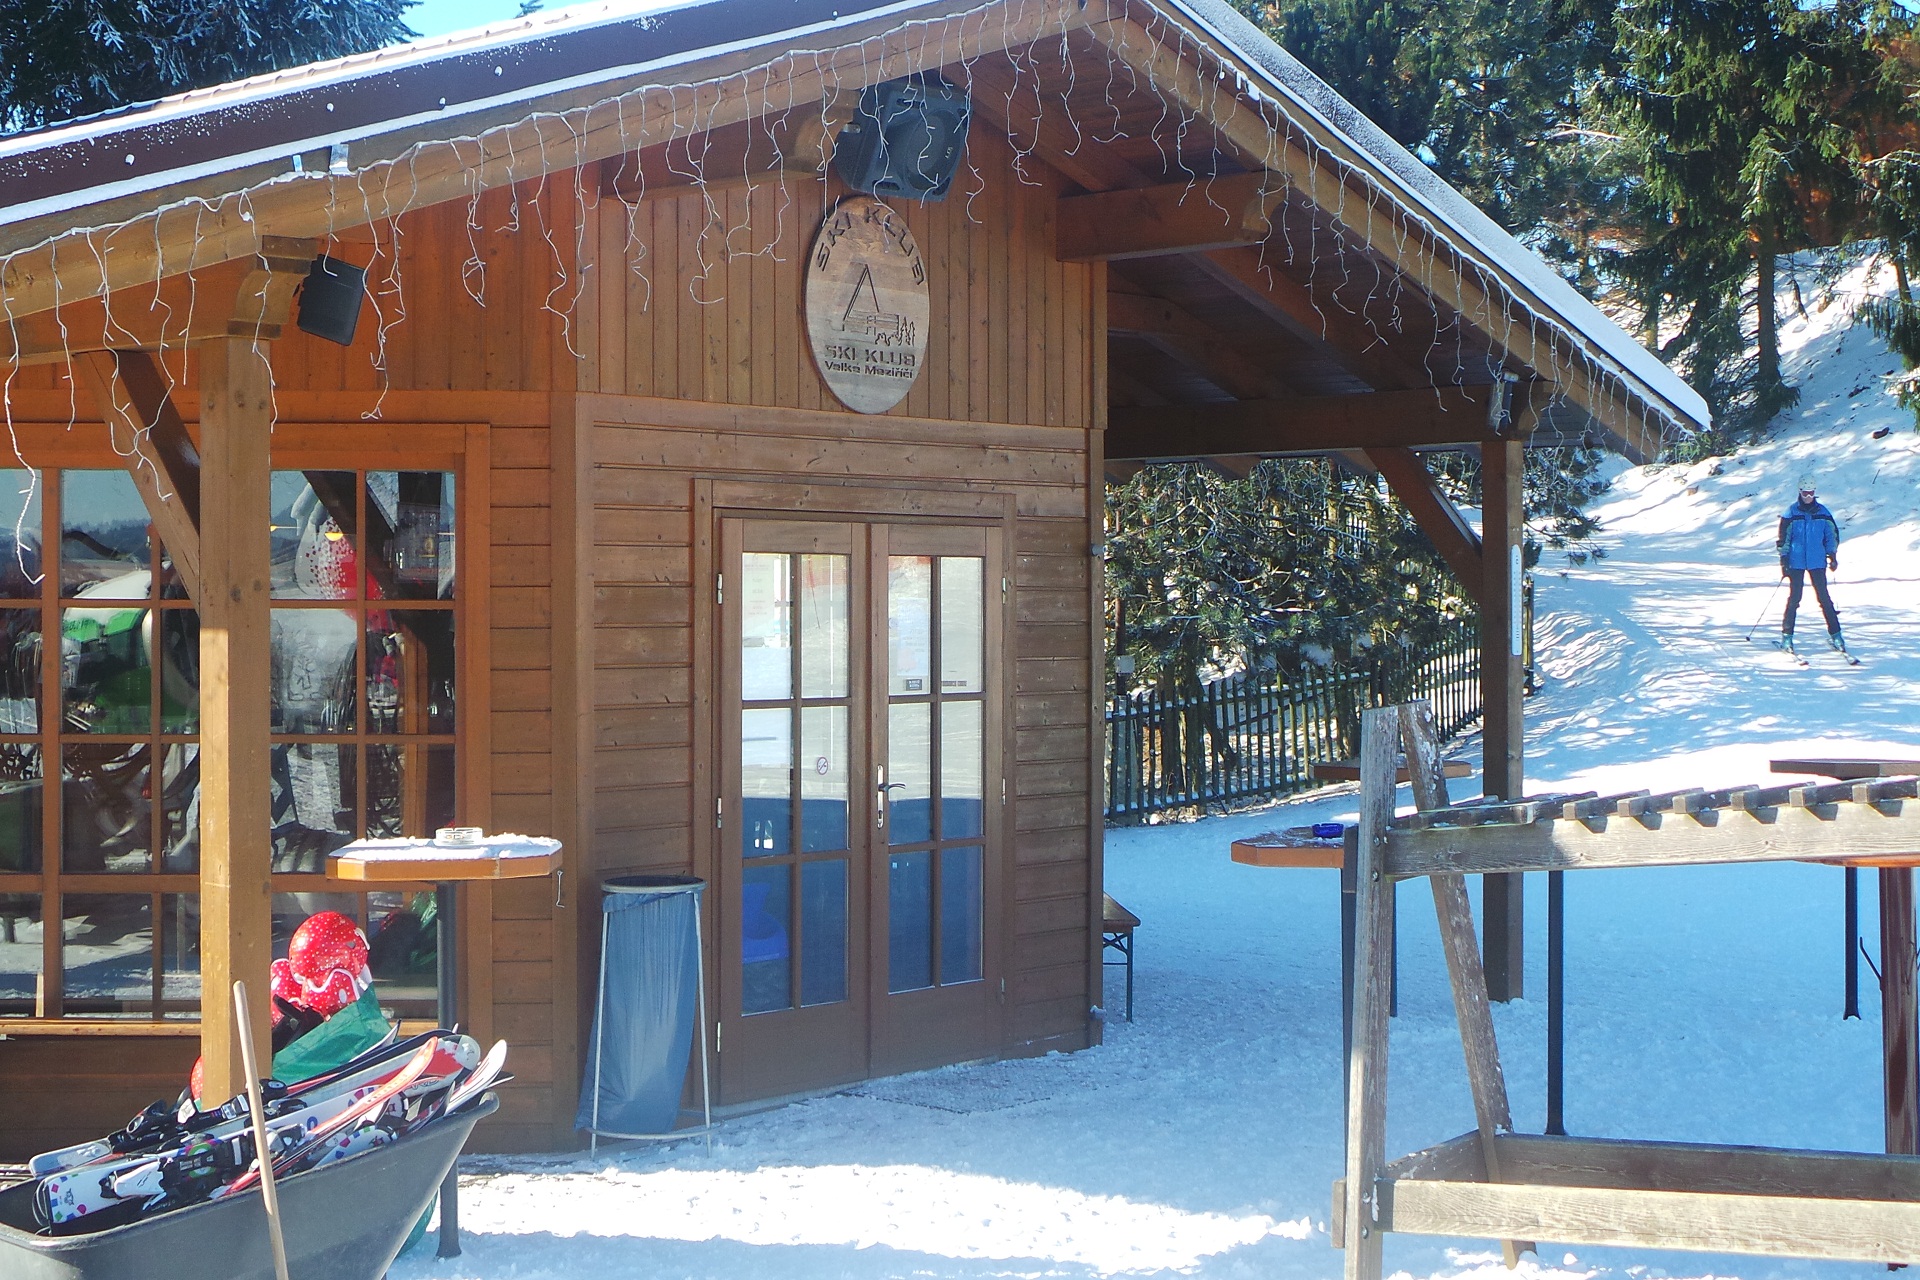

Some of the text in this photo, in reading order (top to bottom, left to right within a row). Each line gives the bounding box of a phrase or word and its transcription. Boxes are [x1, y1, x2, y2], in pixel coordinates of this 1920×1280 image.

[816, 206, 925, 286] SKI KLUB
[825, 344, 916, 367] SKI KLUB
[864, 365, 914, 379] Meziříčí
